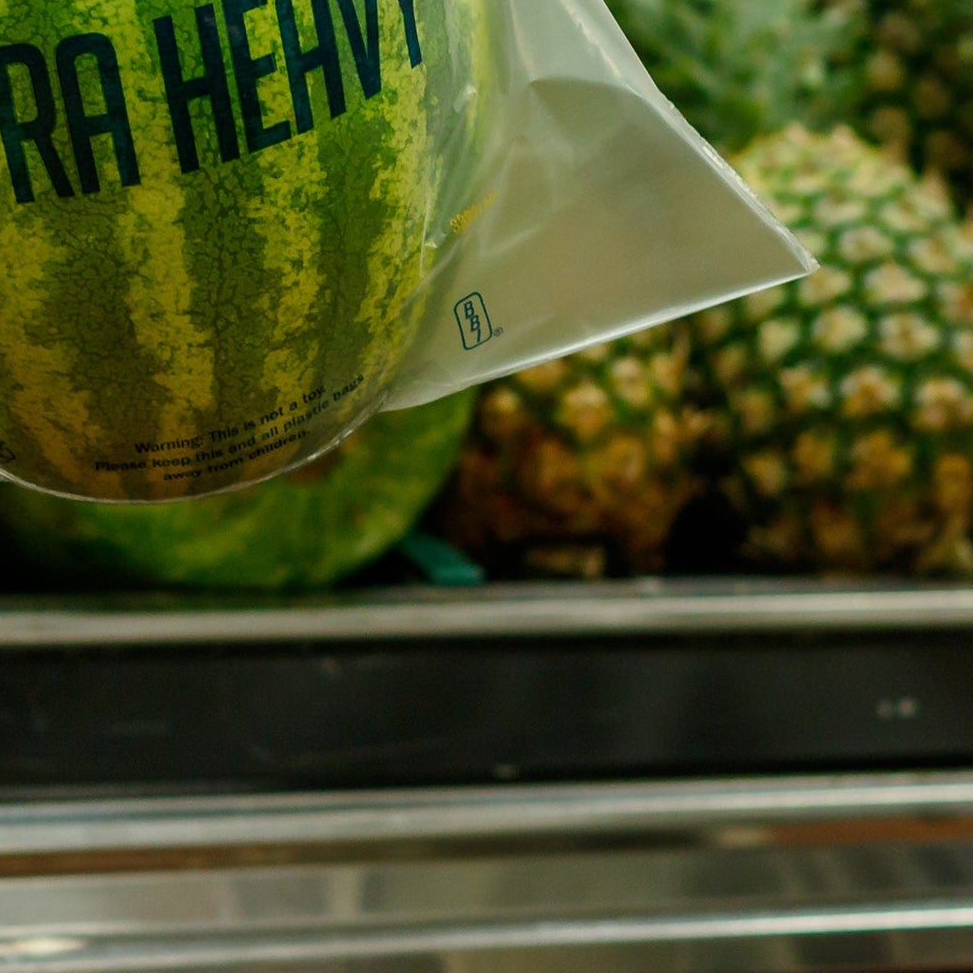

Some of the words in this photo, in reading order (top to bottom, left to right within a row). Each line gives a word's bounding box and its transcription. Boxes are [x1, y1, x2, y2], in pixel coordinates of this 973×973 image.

[95, 459, 147, 471] Please
[153, 456, 191, 469] keep
[196, 447, 223, 462] this
[229, 437, 256, 455] and
[261, 427, 278, 441] all
[283, 400, 328, 432] plastic
[135, 435, 203, 454] Warning:
[209, 426, 239, 443] This
[243, 419, 255, 430] is
[260, 408, 284, 424] not
[289, 401, 297, 411] a
[163, 469, 202, 481] away
[207, 458, 243, 473] from
[249, 429, 310, 460] children.
